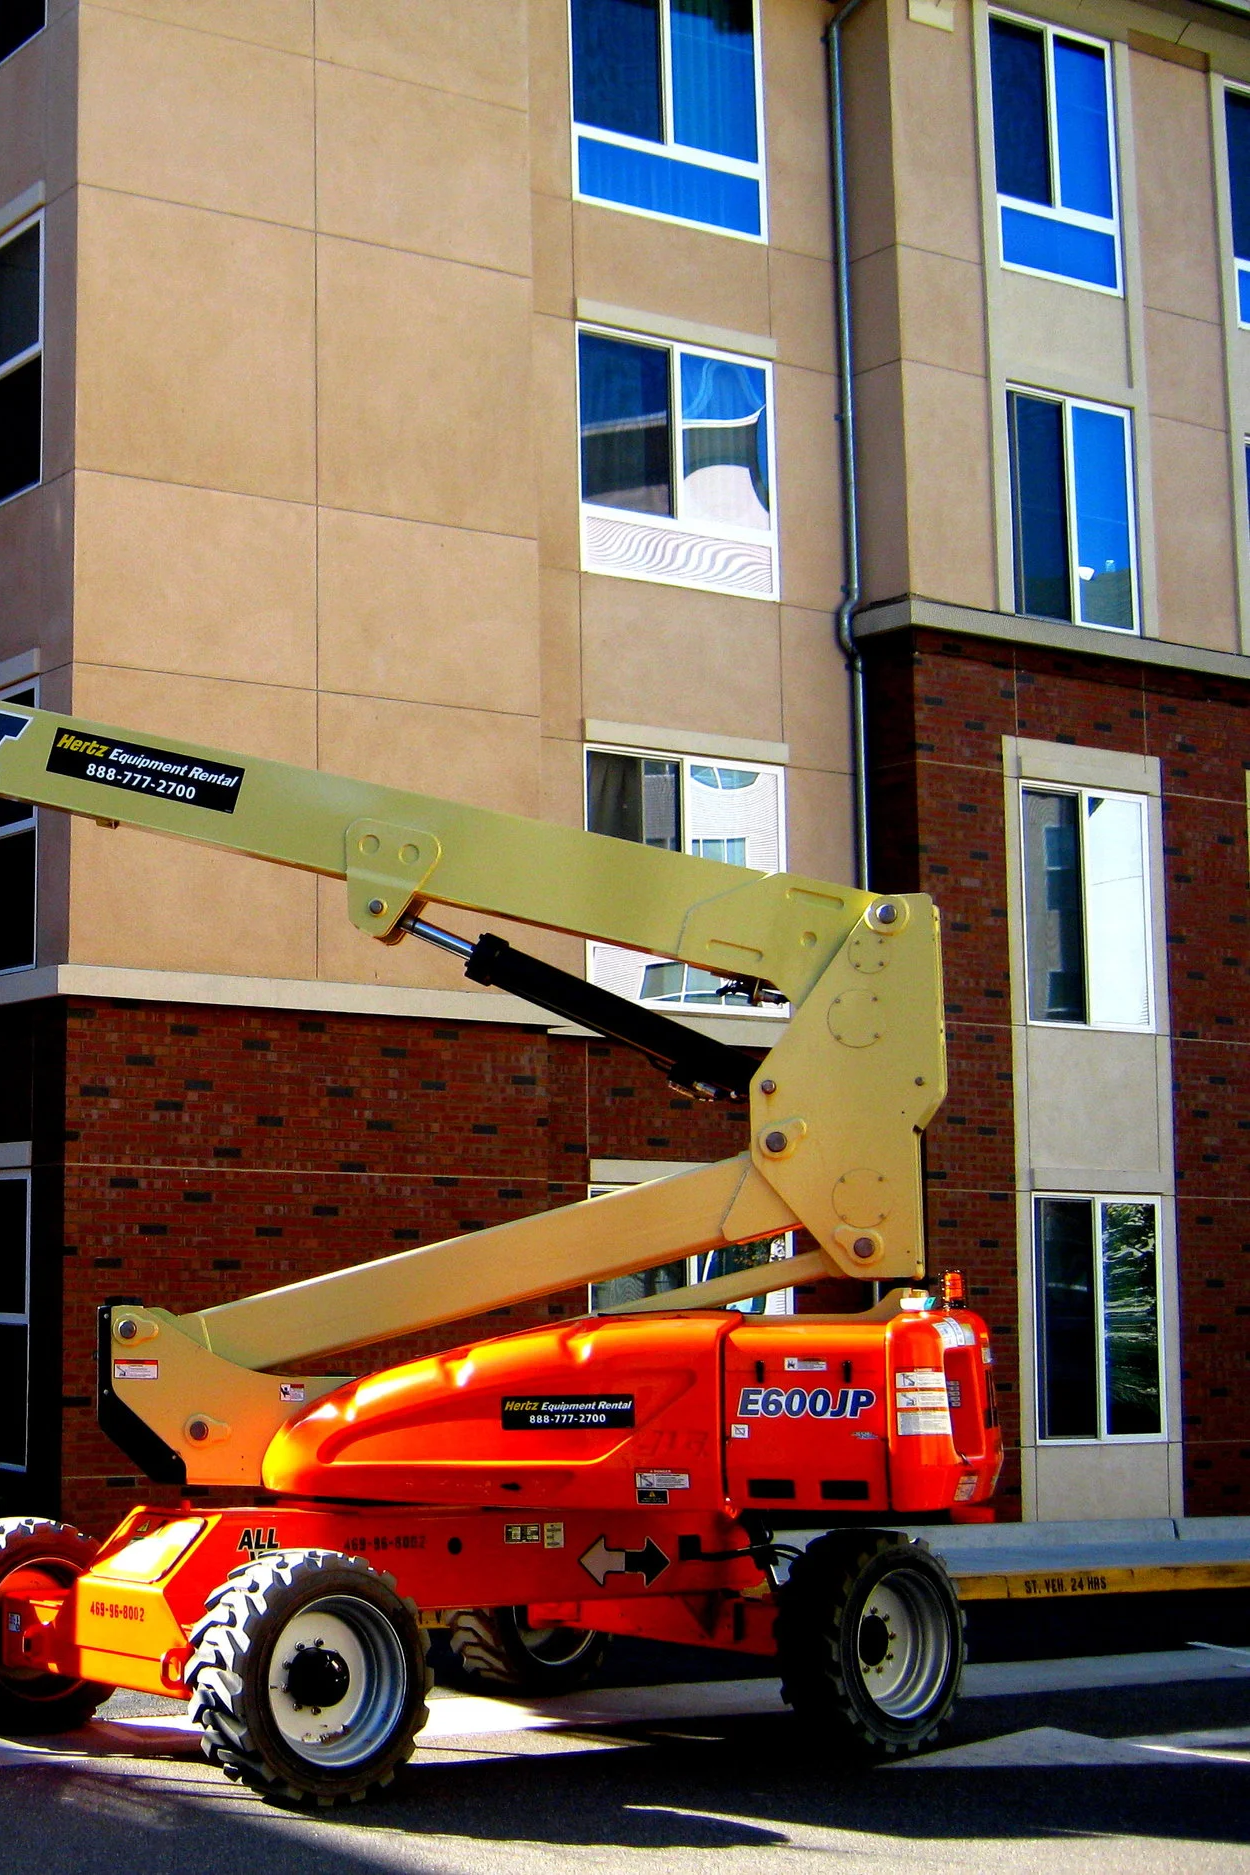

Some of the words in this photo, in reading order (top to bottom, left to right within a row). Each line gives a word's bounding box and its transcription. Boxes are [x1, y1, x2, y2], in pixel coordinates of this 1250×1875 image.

[57, 734, 109, 758] Hertz
[108, 748, 190, 777] Equipment
[187, 766, 240, 788] Rental
[85, 763, 196, 800] 888-777-2700
[504, 1401, 540, 1411] Hertz
[541, 1401, 597, 1412] Equipment
[597, 1400, 633, 1410] Rental
[737, 1387, 876, 1418] E600JP
[529, 1413, 607, 1424] 888-777-2700
[238, 1527, 280, 1551] ALL
[1024, 1580, 1041, 1594] ST.
[1045, 1578, 1067, 1593] VEH.
[1071, 1577, 1084, 1592] 24
[1088, 1575, 1107, 1590] HRS
[90, 1601, 145, 1622] 469-96-8002
